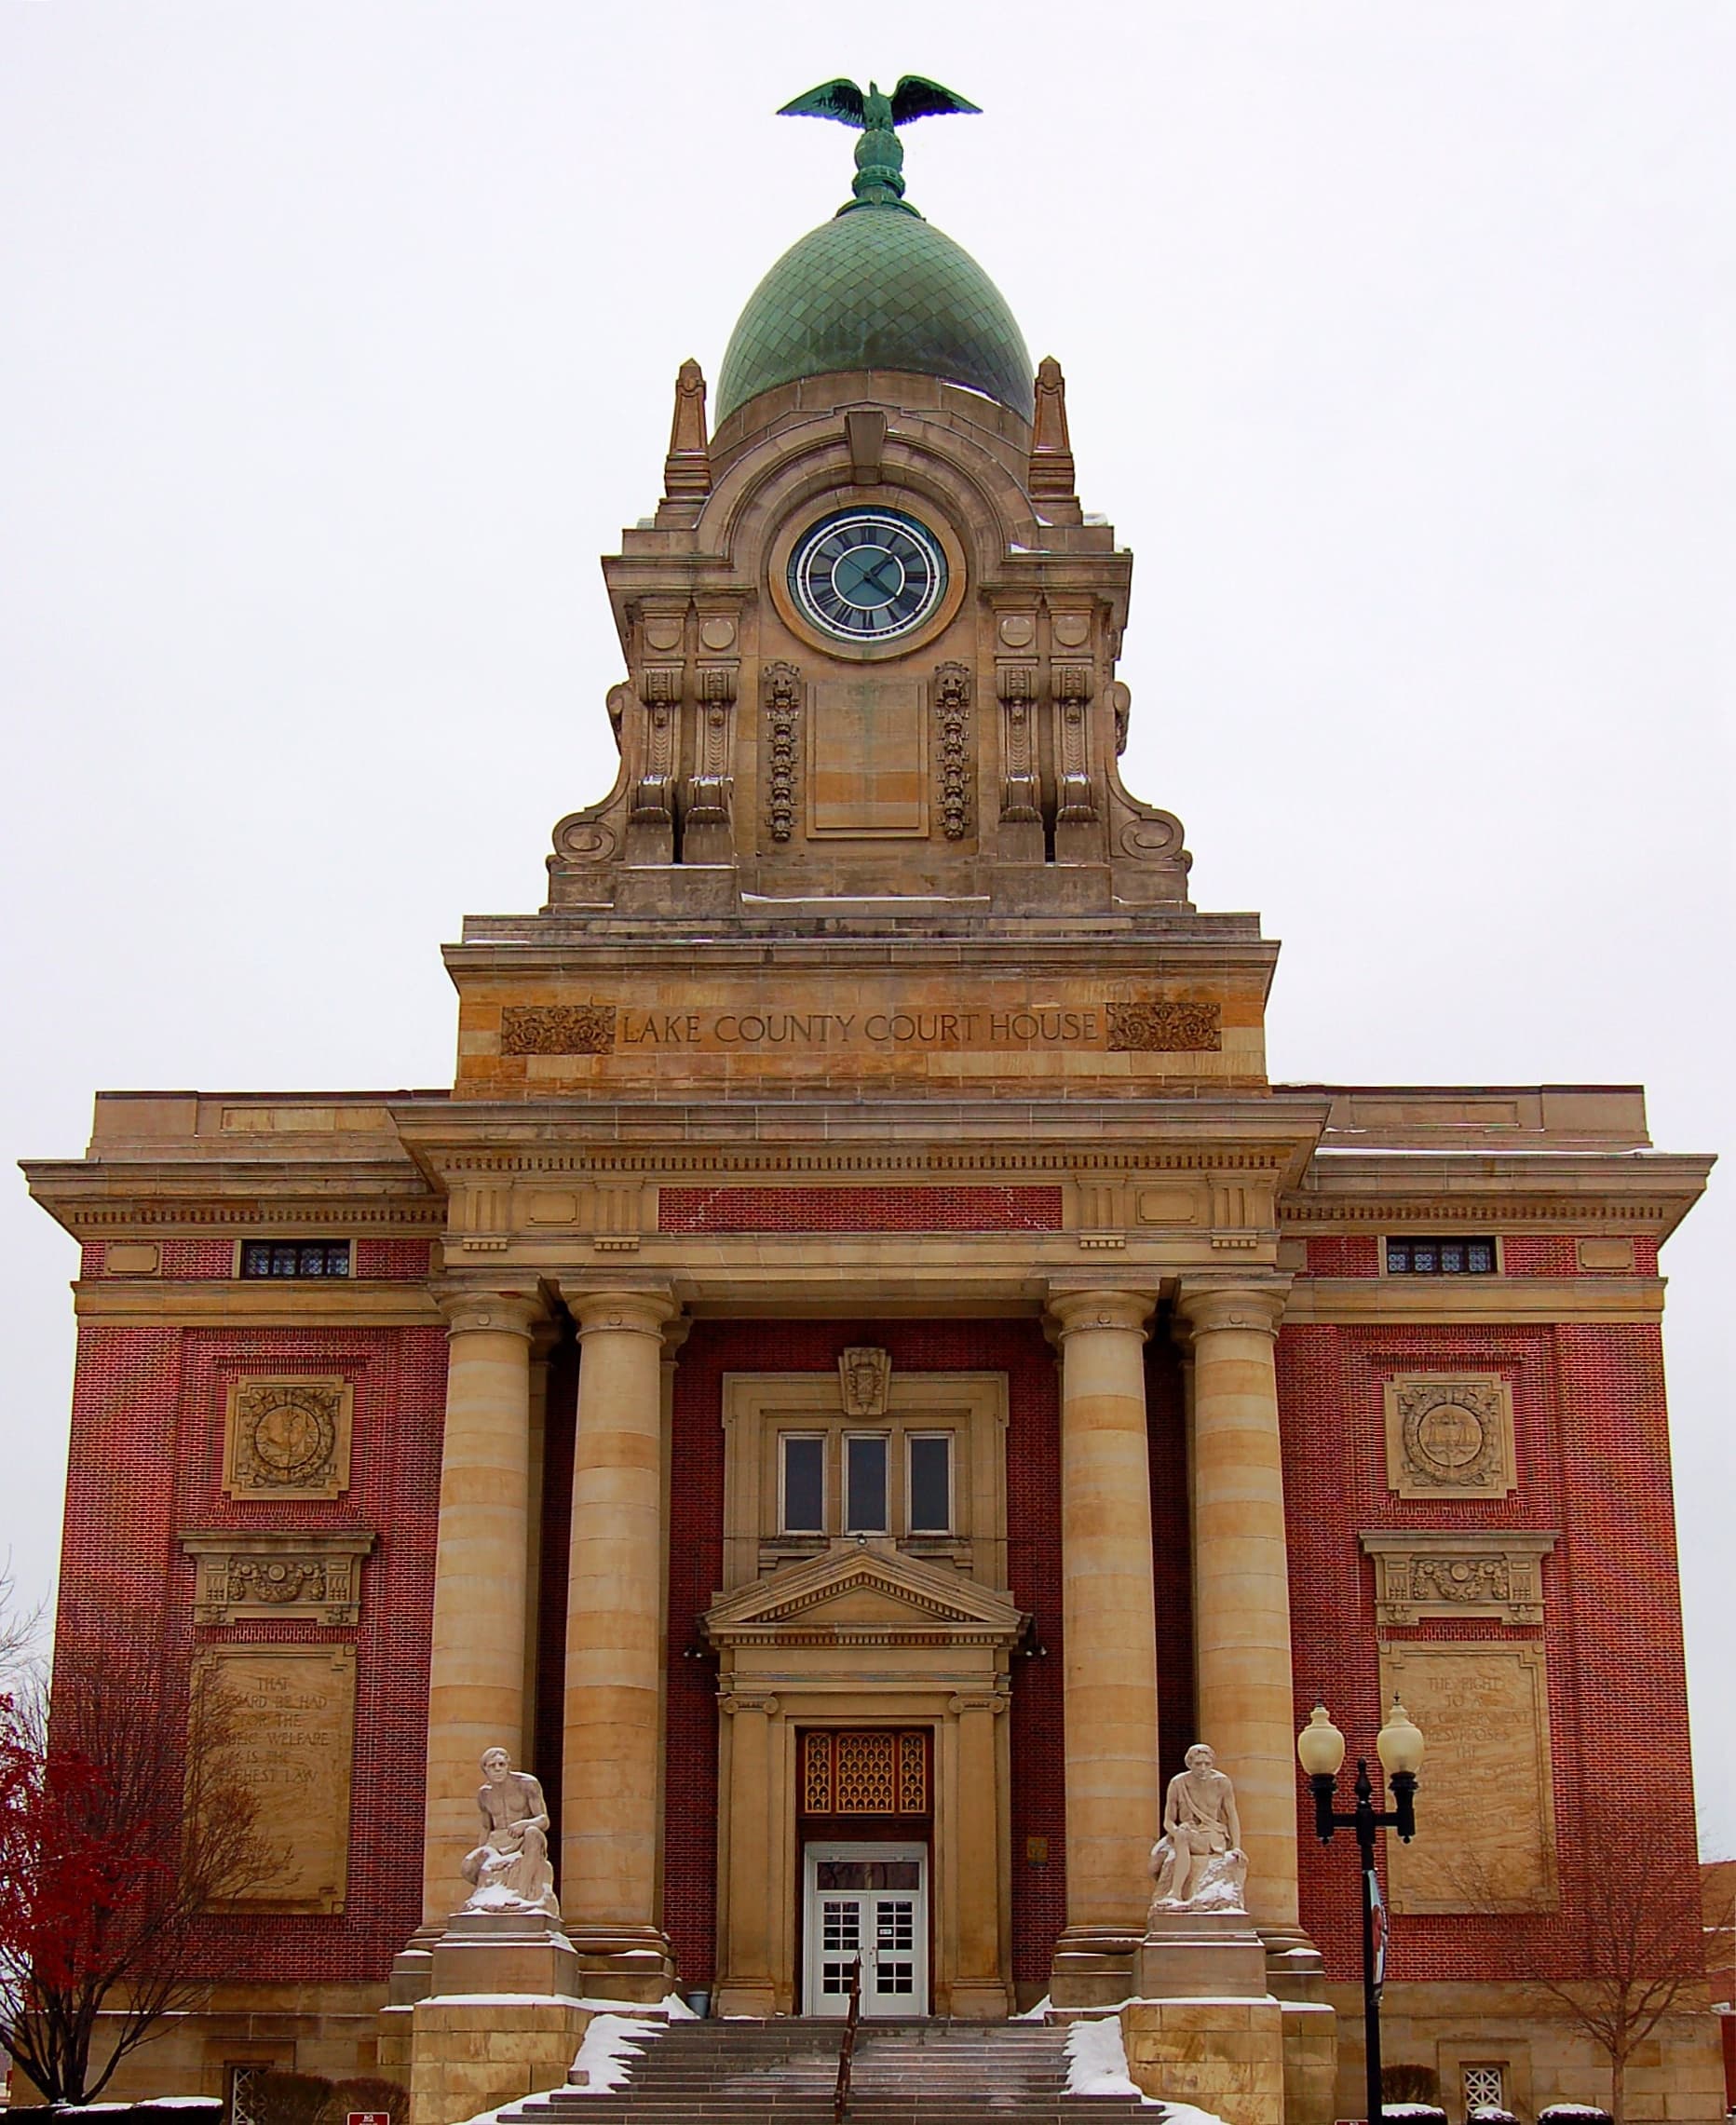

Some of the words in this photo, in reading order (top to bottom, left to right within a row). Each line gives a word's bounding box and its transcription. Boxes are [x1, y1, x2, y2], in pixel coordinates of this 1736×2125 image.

[623, 1016, 701, 1043] LAKE
[714, 1015, 856, 1043] COUNTY
[864, 1014, 980, 1042] COURT
[990, 1014, 1099, 1041] HOUSE
[256, 1677, 290, 1691] THAT
[1427, 1677, 1452, 1691] THE
[1462, 1677, 1502, 1691] RIGHT
[271, 1695, 292, 1708] BE
[299, 1695, 328, 1710] HAD
[1445, 1694, 1464, 1708] TO
[276, 1713, 303, 1727] THE
[1408, 1711, 1431, 1725] REE
[266, 1732, 330, 1746] WELFARE
[246, 1751, 259, 1764] IS
[281, 1768, 318, 1783] LAW
